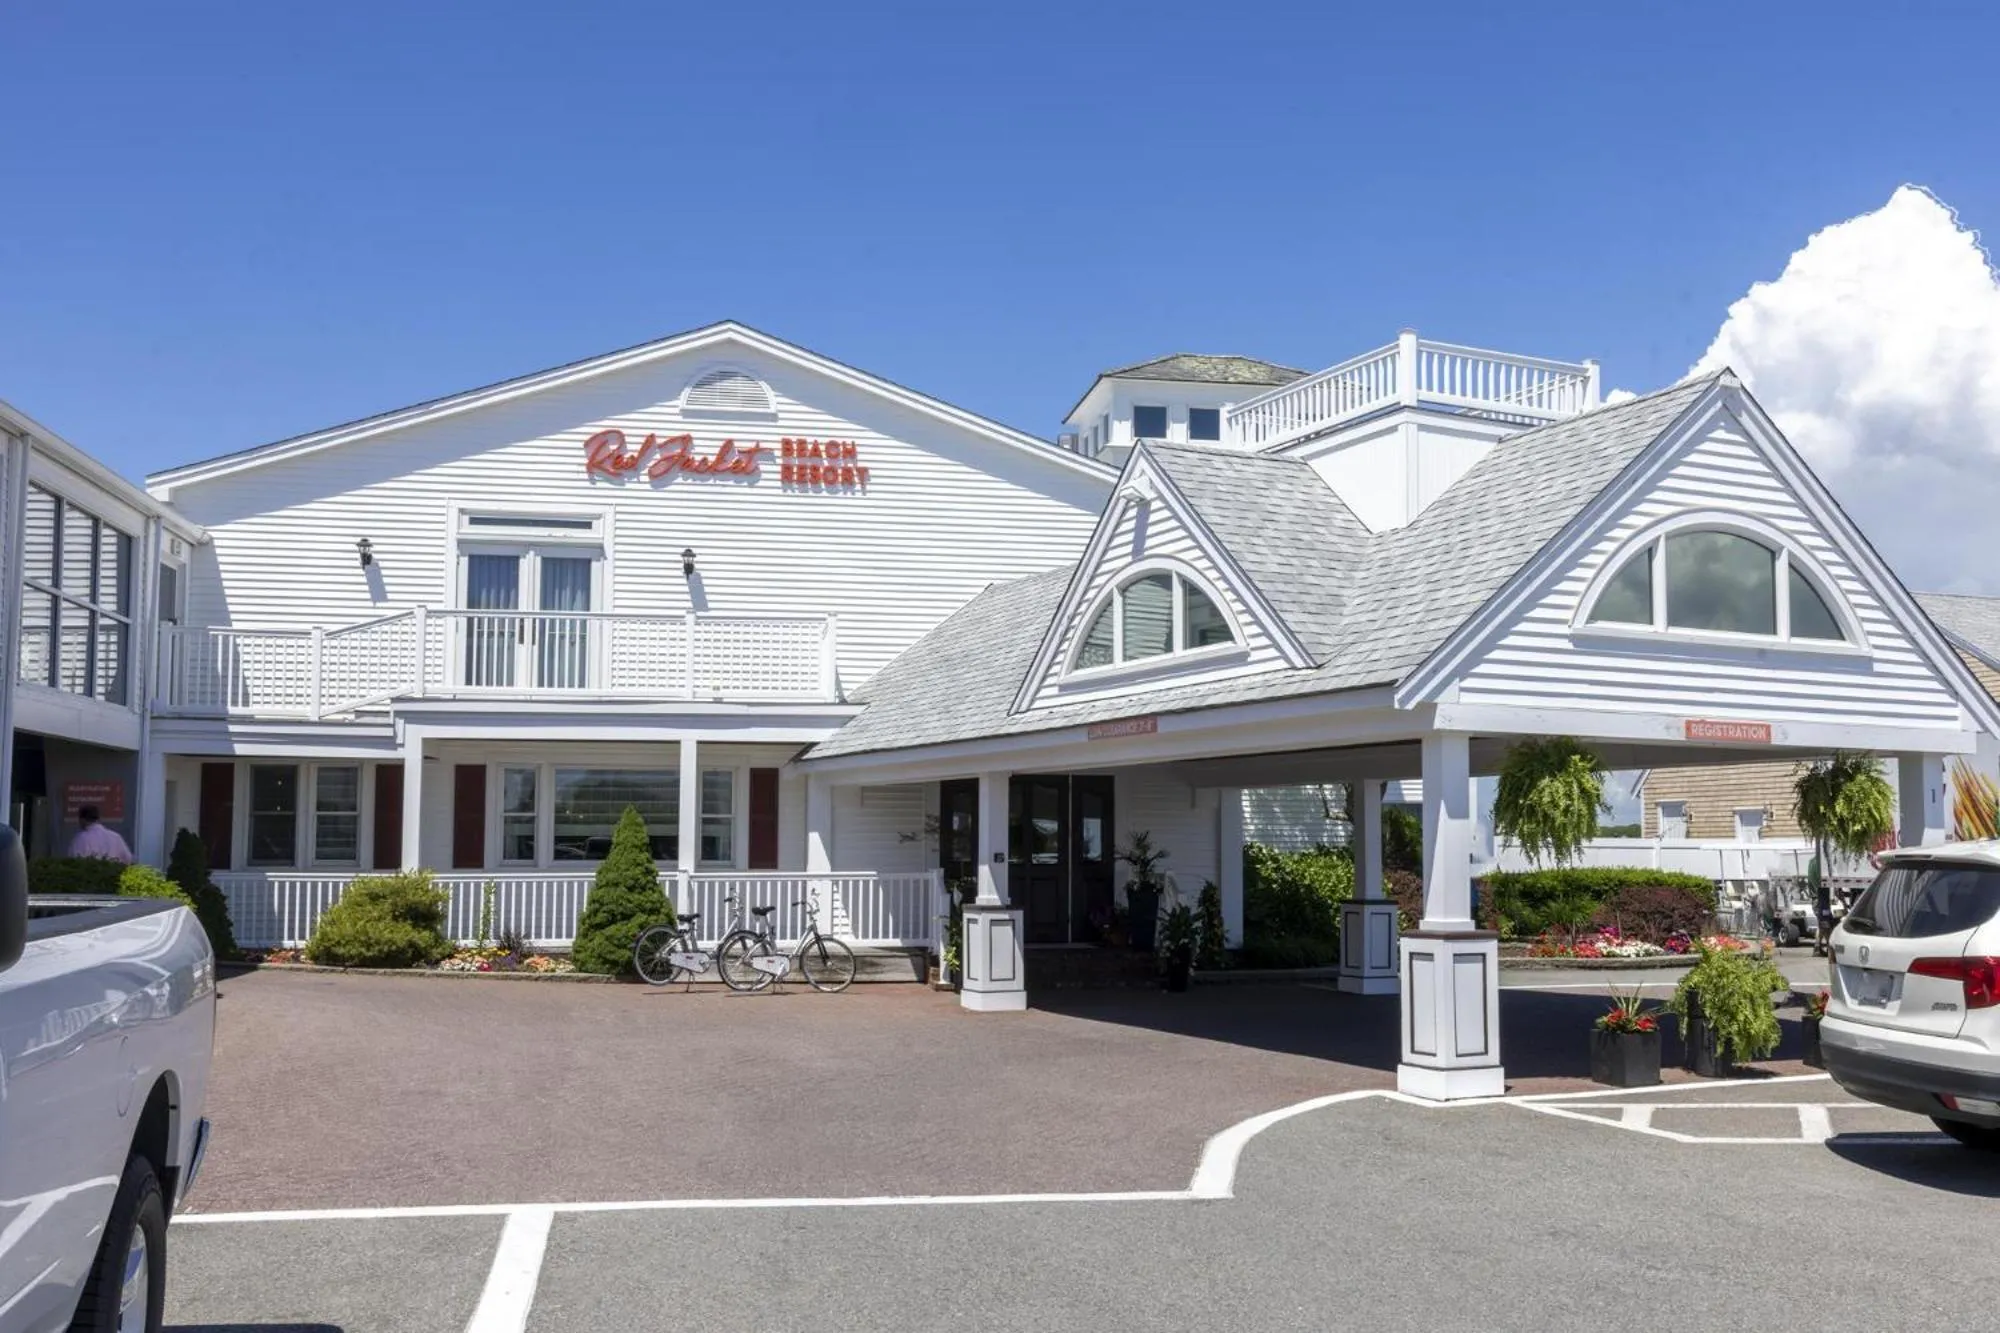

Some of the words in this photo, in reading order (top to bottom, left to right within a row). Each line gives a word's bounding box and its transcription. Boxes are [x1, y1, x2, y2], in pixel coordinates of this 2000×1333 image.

[584, 429, 656, 477] Red
[648, 433, 774, 478] Jacket
[780, 437, 857, 459] BEACH
[780, 463, 869, 486] RESORT
[1691, 723, 1766, 739] REGISTRATION
